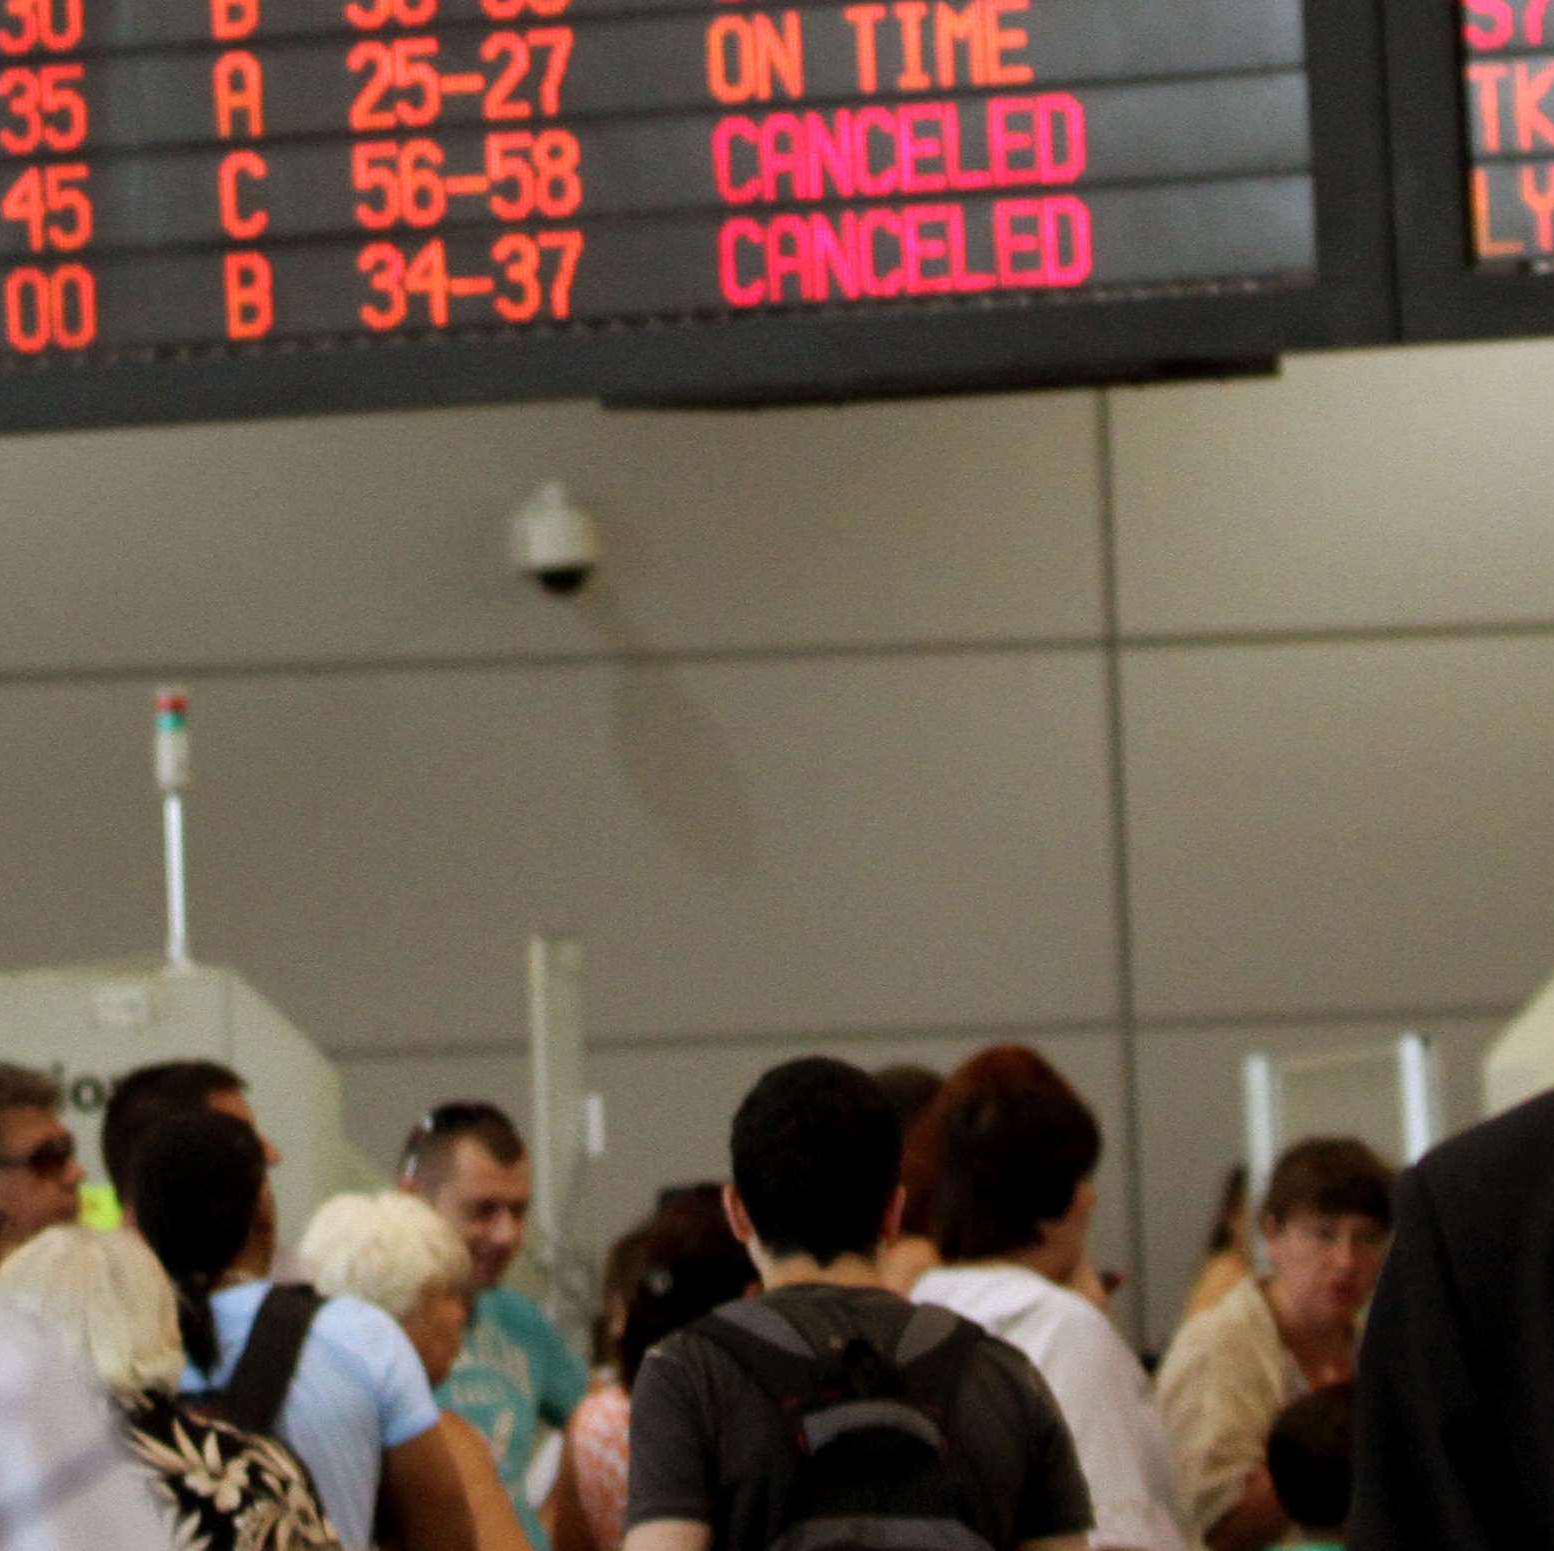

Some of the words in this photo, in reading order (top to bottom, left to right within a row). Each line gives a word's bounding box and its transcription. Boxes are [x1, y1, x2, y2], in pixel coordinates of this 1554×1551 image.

[347, 25, 576, 132] 25-27
[352, 127, 584, 231] 56-58
[224, 250, 275, 340] B
[357, 229, 586, 331] 34-37
[717, 193, 1095, 308] CANCELED
